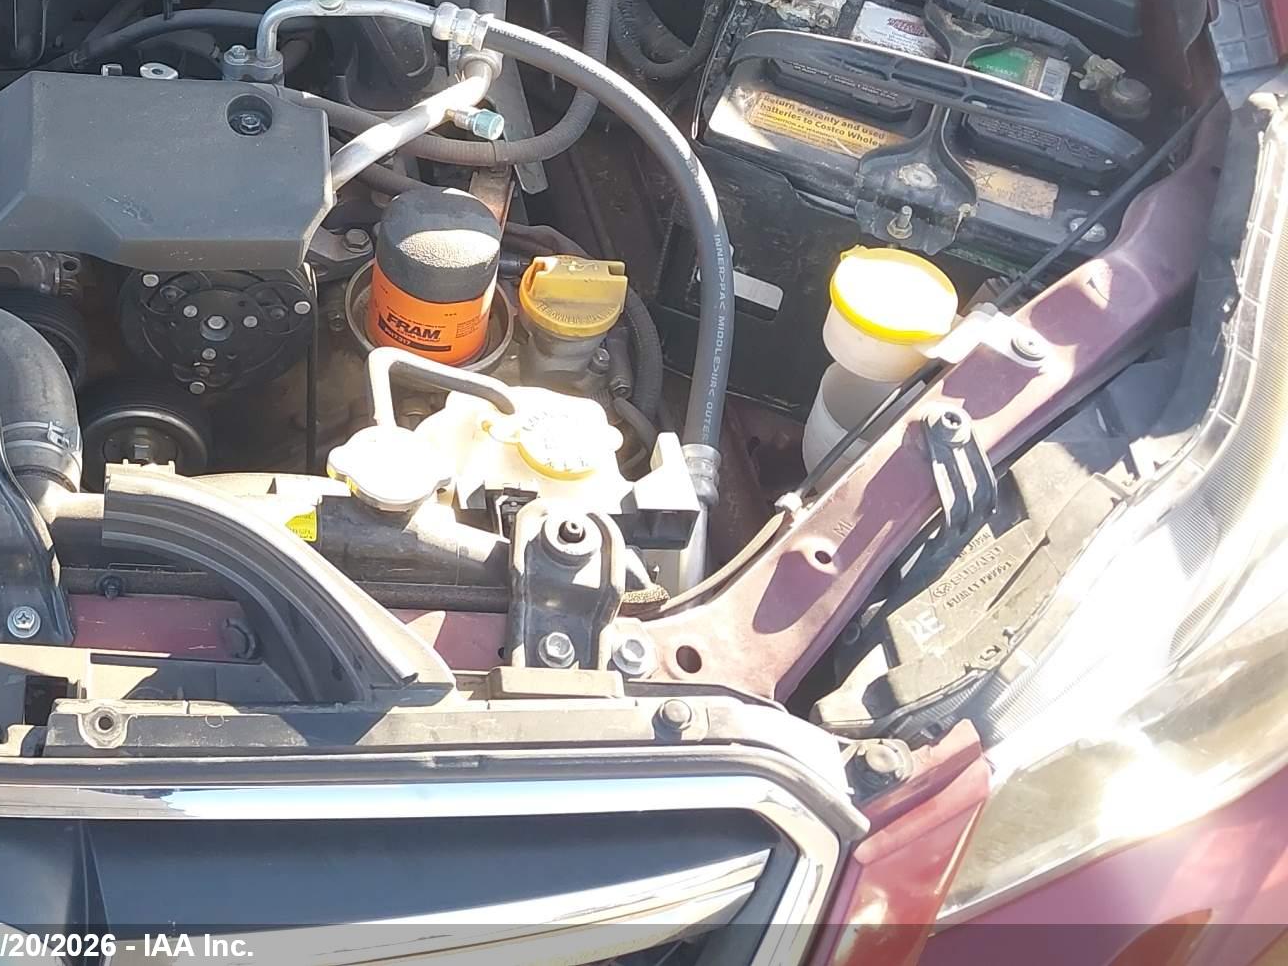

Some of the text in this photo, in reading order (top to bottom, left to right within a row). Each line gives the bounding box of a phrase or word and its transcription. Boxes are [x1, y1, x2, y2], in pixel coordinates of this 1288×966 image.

[761, 103, 801, 122] batteries
[803, 115, 813, 126] to
[815, 120, 845, 136] Costco
[764, 95, 885, 140] Return warranty and used
[387, 312, 441, 340] FRAM
